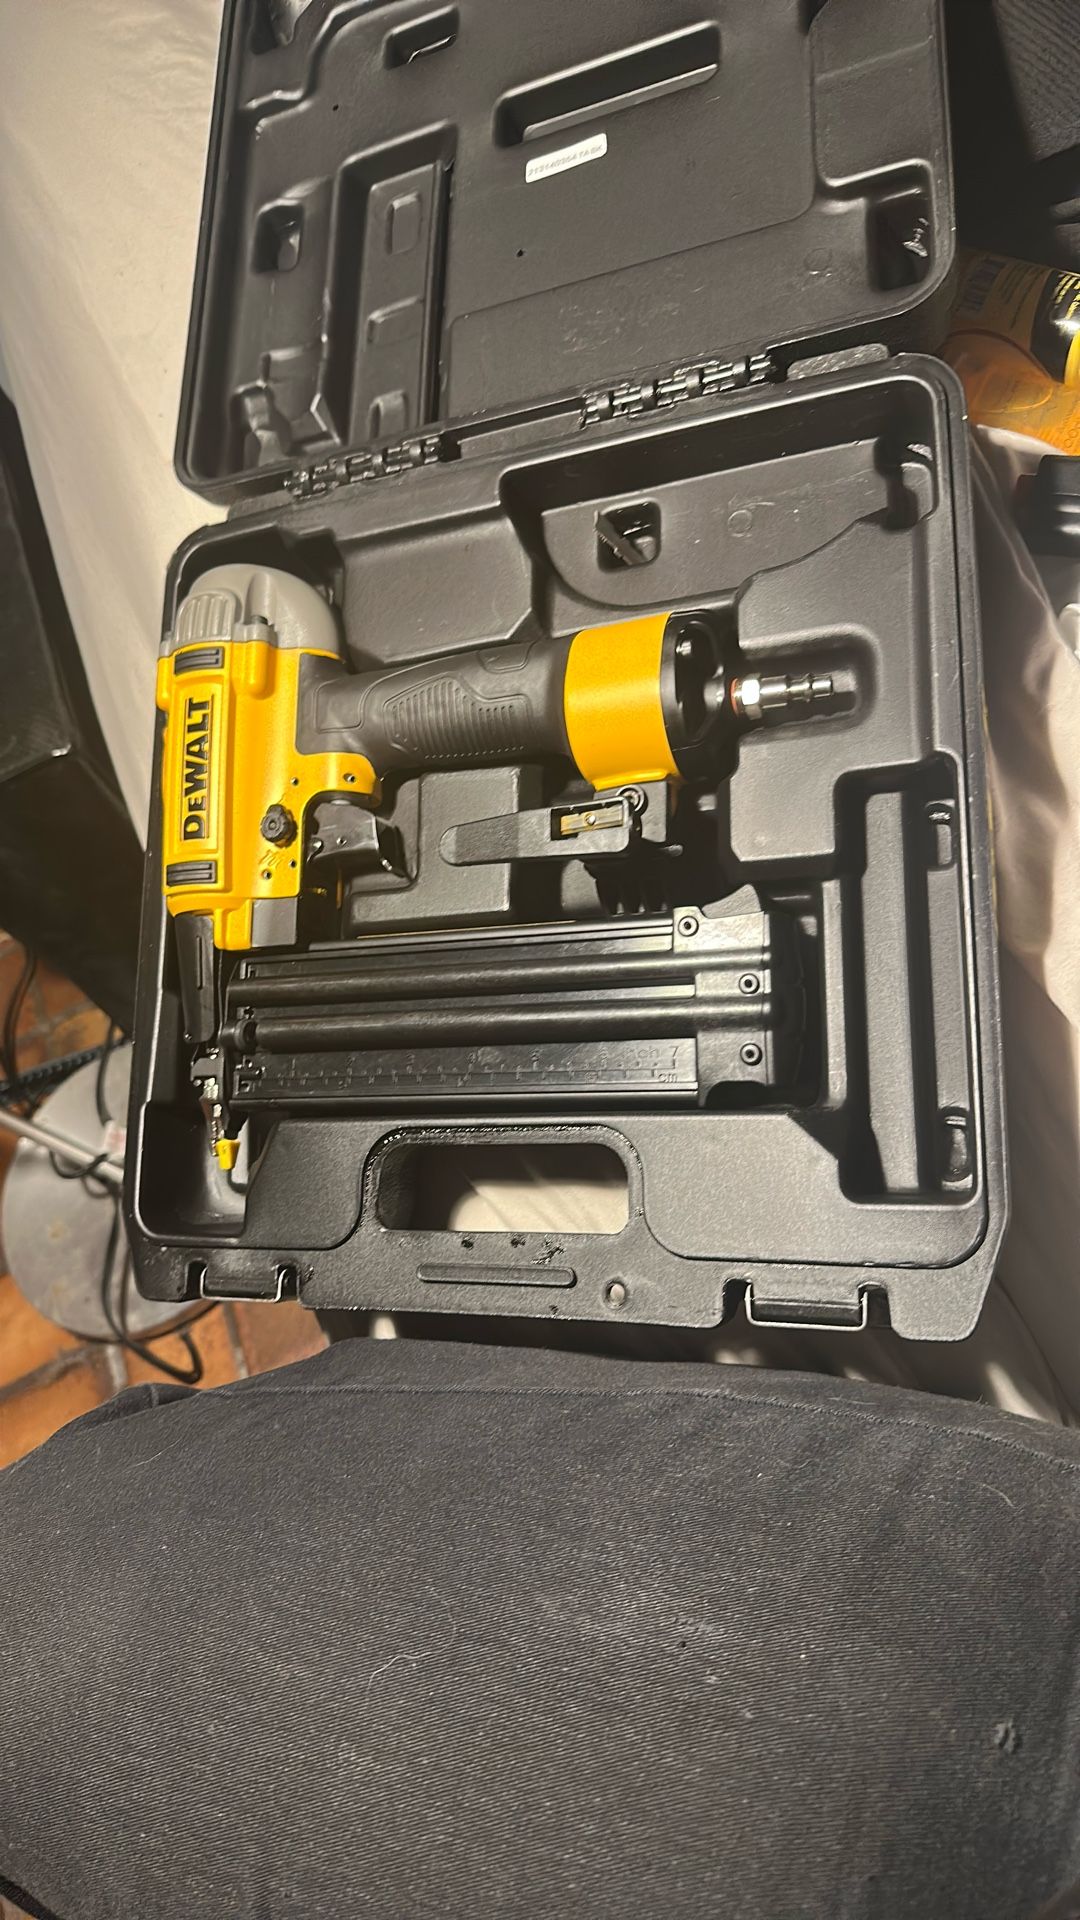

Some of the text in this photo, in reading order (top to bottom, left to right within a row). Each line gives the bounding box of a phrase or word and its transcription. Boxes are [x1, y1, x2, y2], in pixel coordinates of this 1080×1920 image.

[183, 697, 210, 841] DEWALT
[668, 1045, 680, 1058] 7
[657, 1072, 679, 1084] cm
